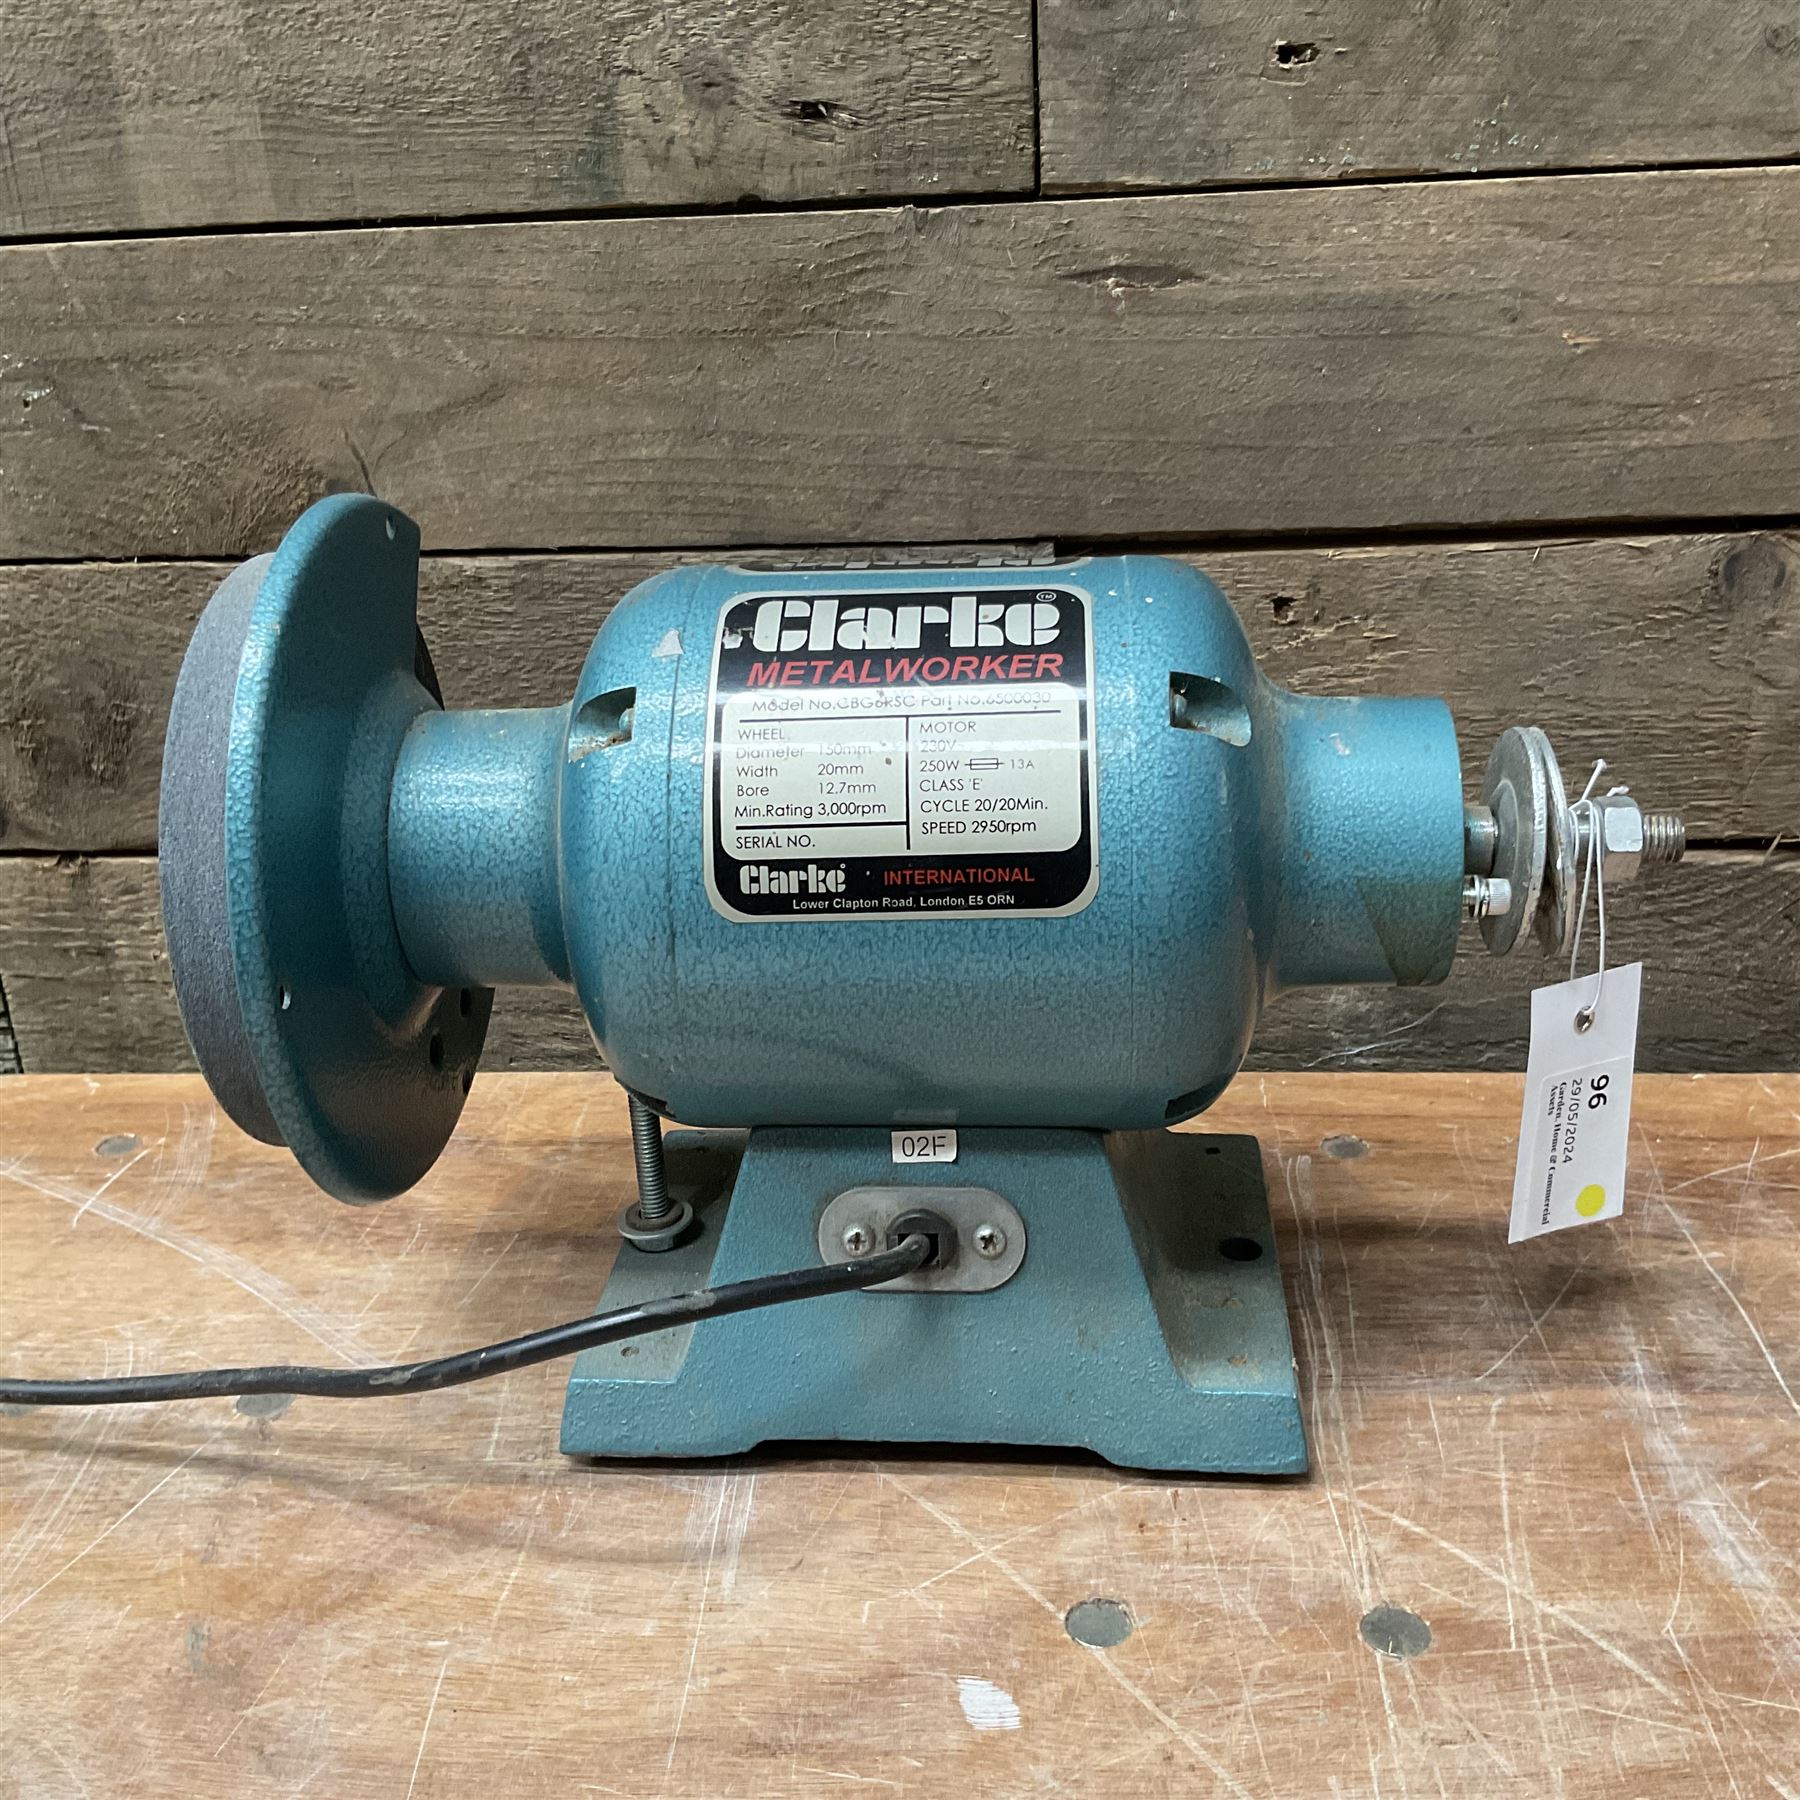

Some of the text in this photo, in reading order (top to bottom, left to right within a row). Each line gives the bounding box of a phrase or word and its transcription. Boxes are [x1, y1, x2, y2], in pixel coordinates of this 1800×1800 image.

[752, 596, 1060, 652] Clarke
[746, 653, 1063, 688] METALWORKER
[752, 699, 804, 712] Model
[738, 728, 785, 741] WHEEL
[920, 721, 977, 734] MOTOR
[736, 743, 872, 759] Diameter 150mm
[736, 764, 864, 778] Width 20mm
[919, 759, 1035, 772] 250W 13A
[737, 782, 877, 797] Bore 12.7mm
[919, 779, 964, 792] CLASS
[734, 802, 887, 819] Min.Rating 3,000rpm
[920, 797, 1048, 813] CYCLE 20/20Min.
[921, 820, 1037, 835] SPEED 2950rpm
[736, 834, 816, 849] SERIAL NO.
[739, 864, 846, 894] Clarke
[884, 867, 1036, 886] INTERNATIONAL
[793, 899, 829, 910] Lower
[833, 898, 879, 911] Clapton
[882, 896, 916, 909] Road,
[920, 895, 965, 907] London
[968, 895, 984, 906] E5
[1548, 1085, 1558, 1115] Assets
[1588, 1074, 1609, 1110] 96
[1562, 1078, 1583, 1163] 29/05/2024
[1551, 1123, 1561, 1153] Home
[902, 1136, 946, 1157] 02F
[1550, 1155, 1558, 1164] &
[1541, 1166, 1556, 1225] Commercial
